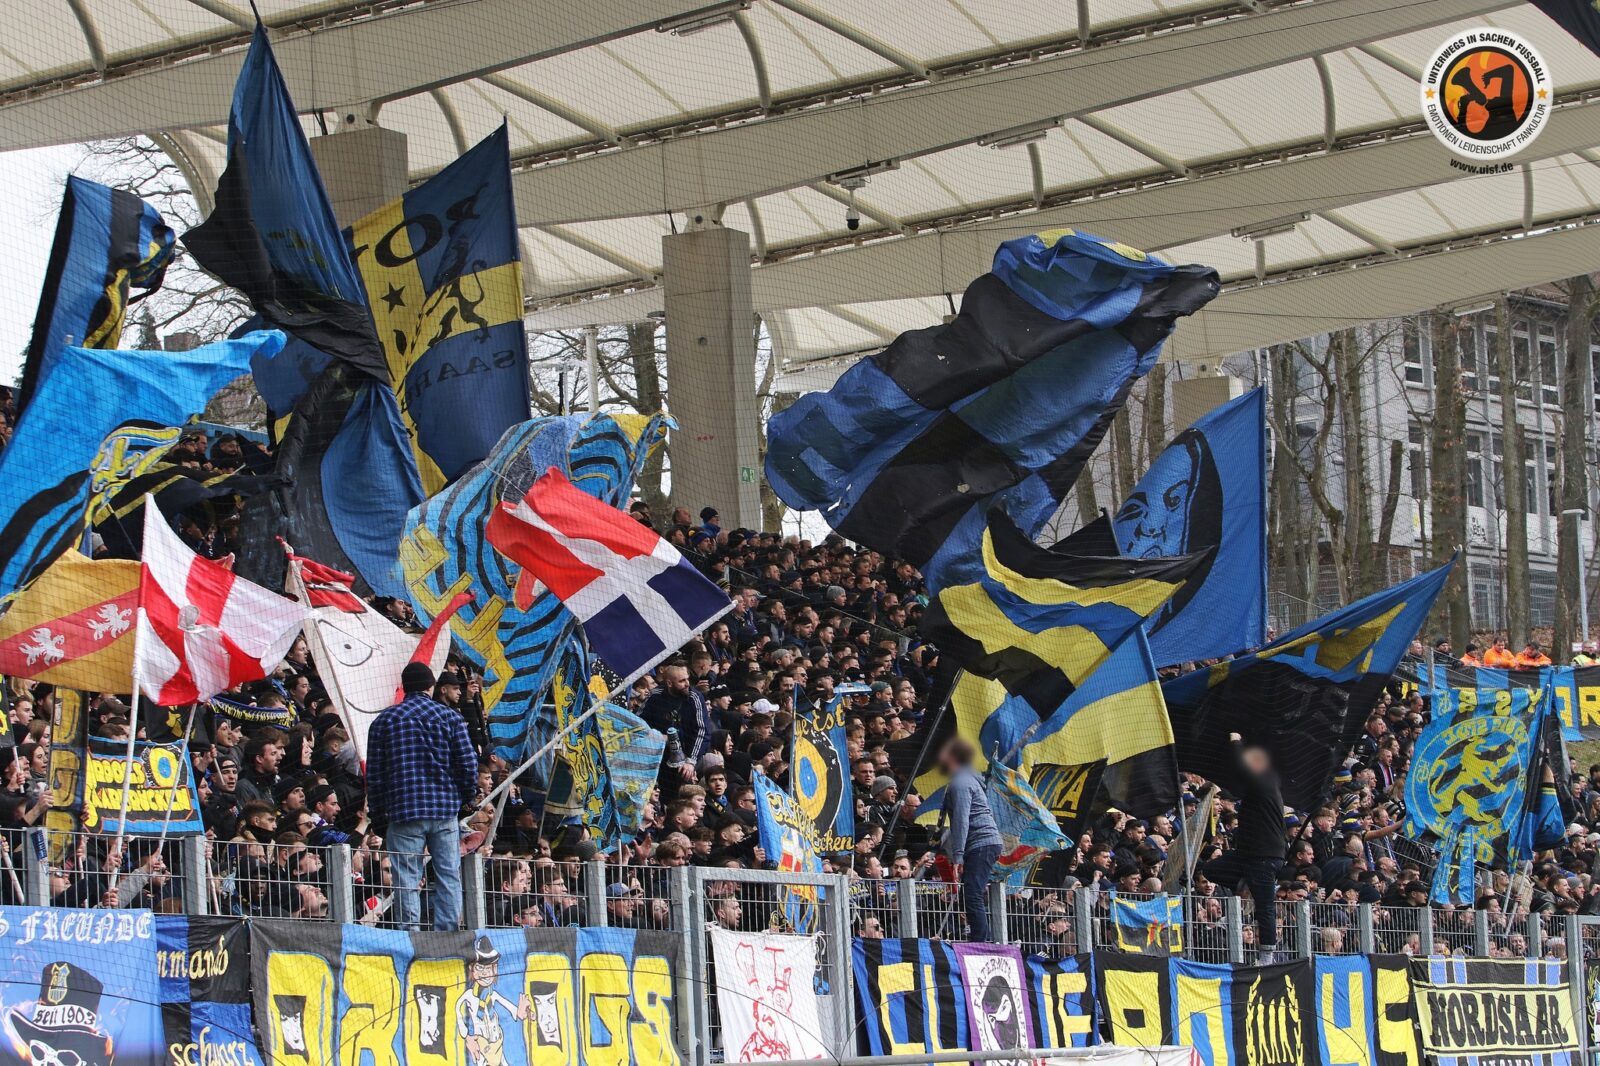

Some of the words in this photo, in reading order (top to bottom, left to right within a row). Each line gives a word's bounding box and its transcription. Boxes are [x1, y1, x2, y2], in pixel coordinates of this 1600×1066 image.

[812, 703, 845, 731] Est
[16, 911, 152, 945] FREUNDE
[35, 1006, 57, 1025] seit
[61, 1005, 96, 1025] 1903
[1427, 991, 1569, 1047] NORDSAAR
